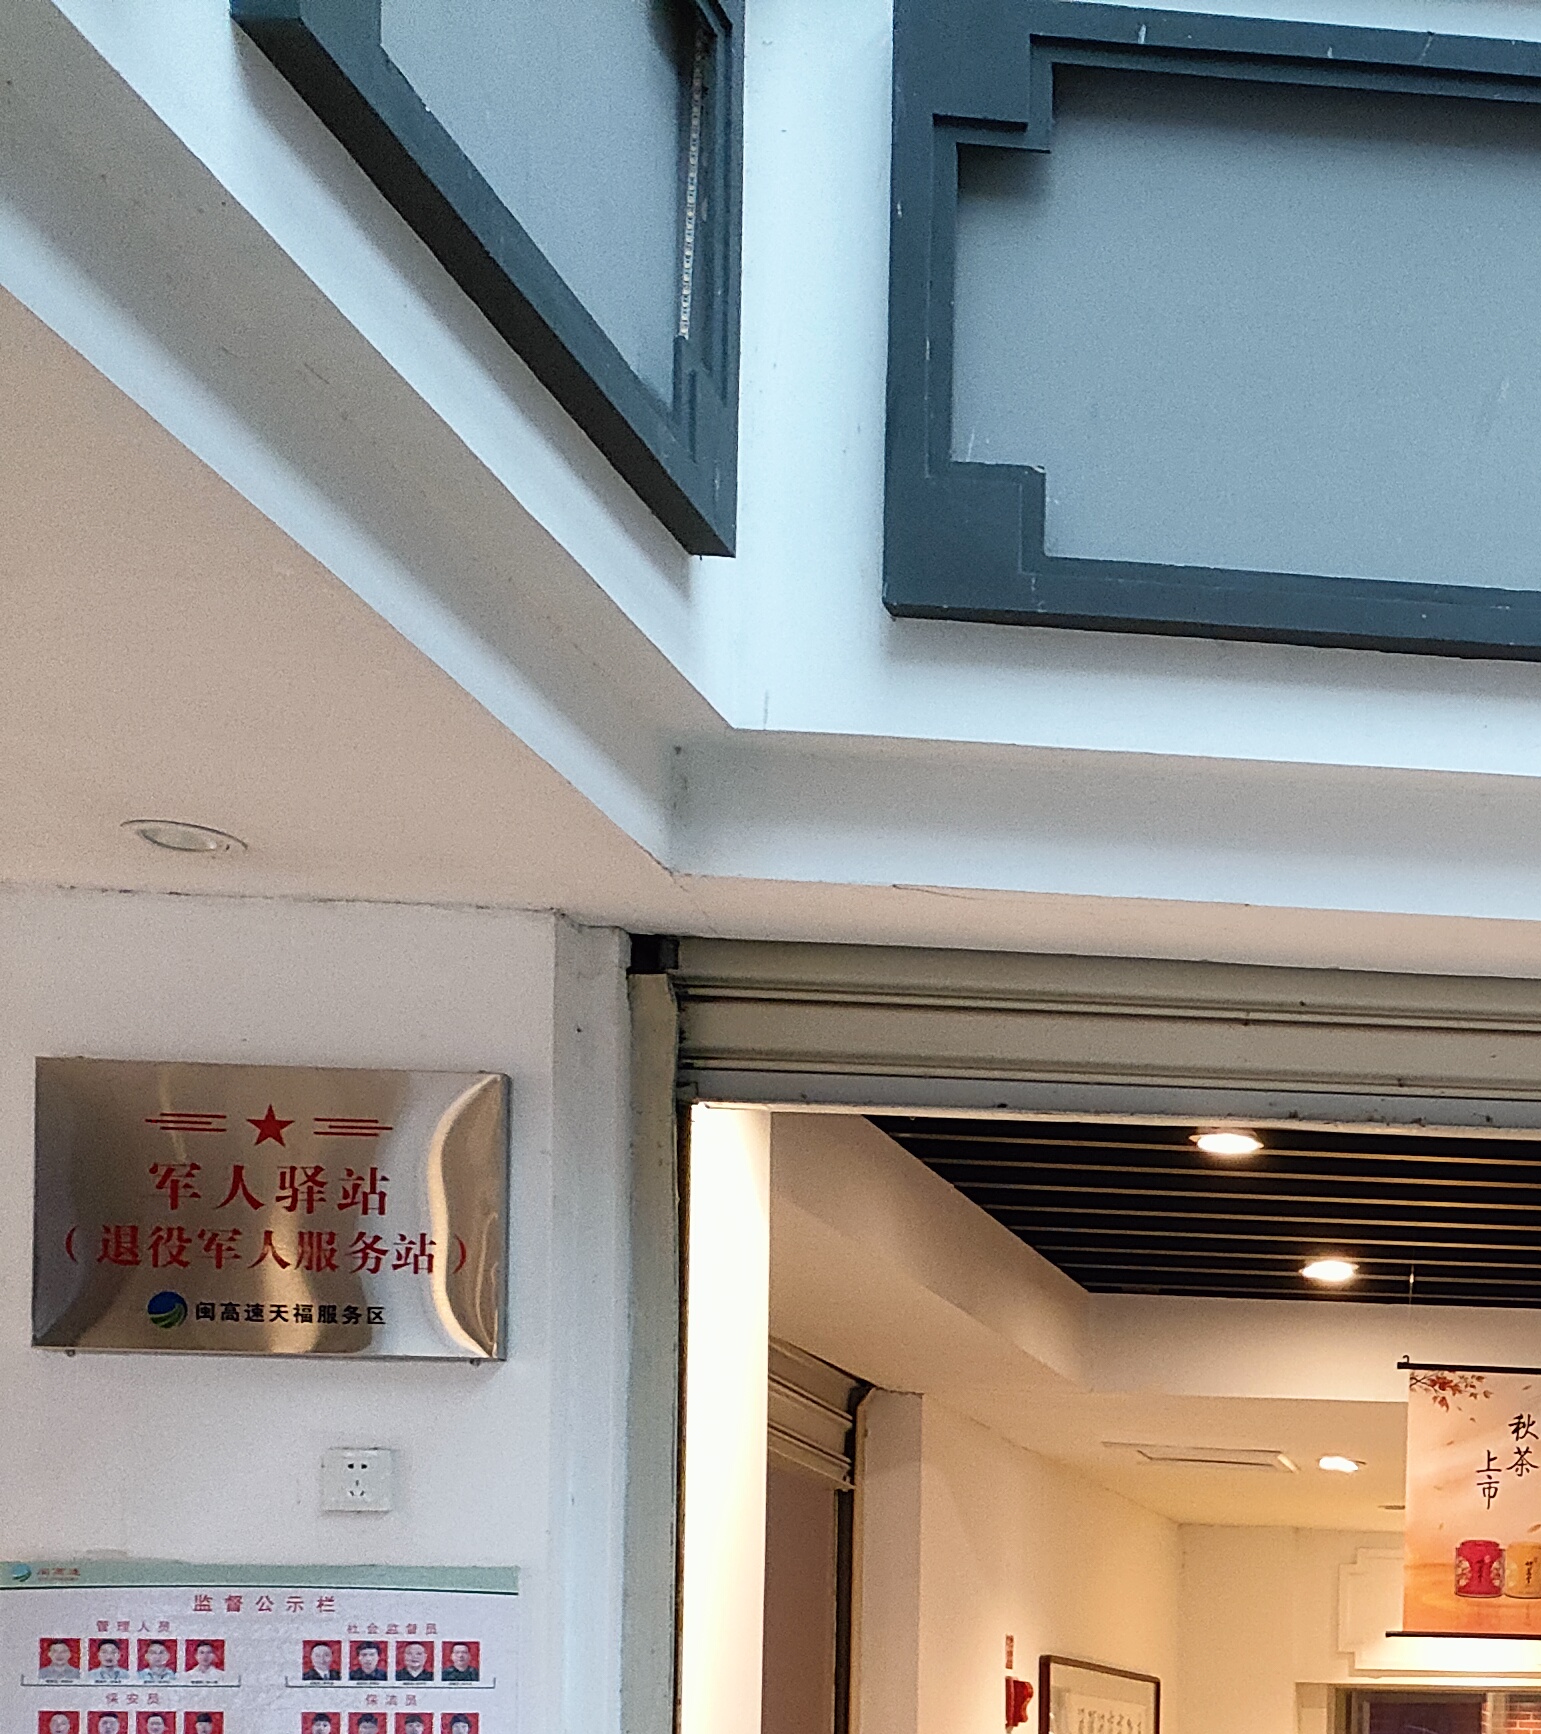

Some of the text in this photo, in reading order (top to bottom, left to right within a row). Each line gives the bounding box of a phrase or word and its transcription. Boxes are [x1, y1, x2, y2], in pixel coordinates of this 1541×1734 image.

[149, 1162, 391, 1216] 军人驿站
[65, 1225, 467, 1275] （退役军人服务站）
[194, 1301, 387, 1325] 闽高速天福服务区
[1506, 1413, 1540, 1478] 秋茶
[1475, 1449, 1502, 1510] 上市
[193, 1594, 337, 1613] 监督公示栏
[96, 1620, 171, 1633] 管理人员
[347, 1623, 438, 1635] 社会监督员
